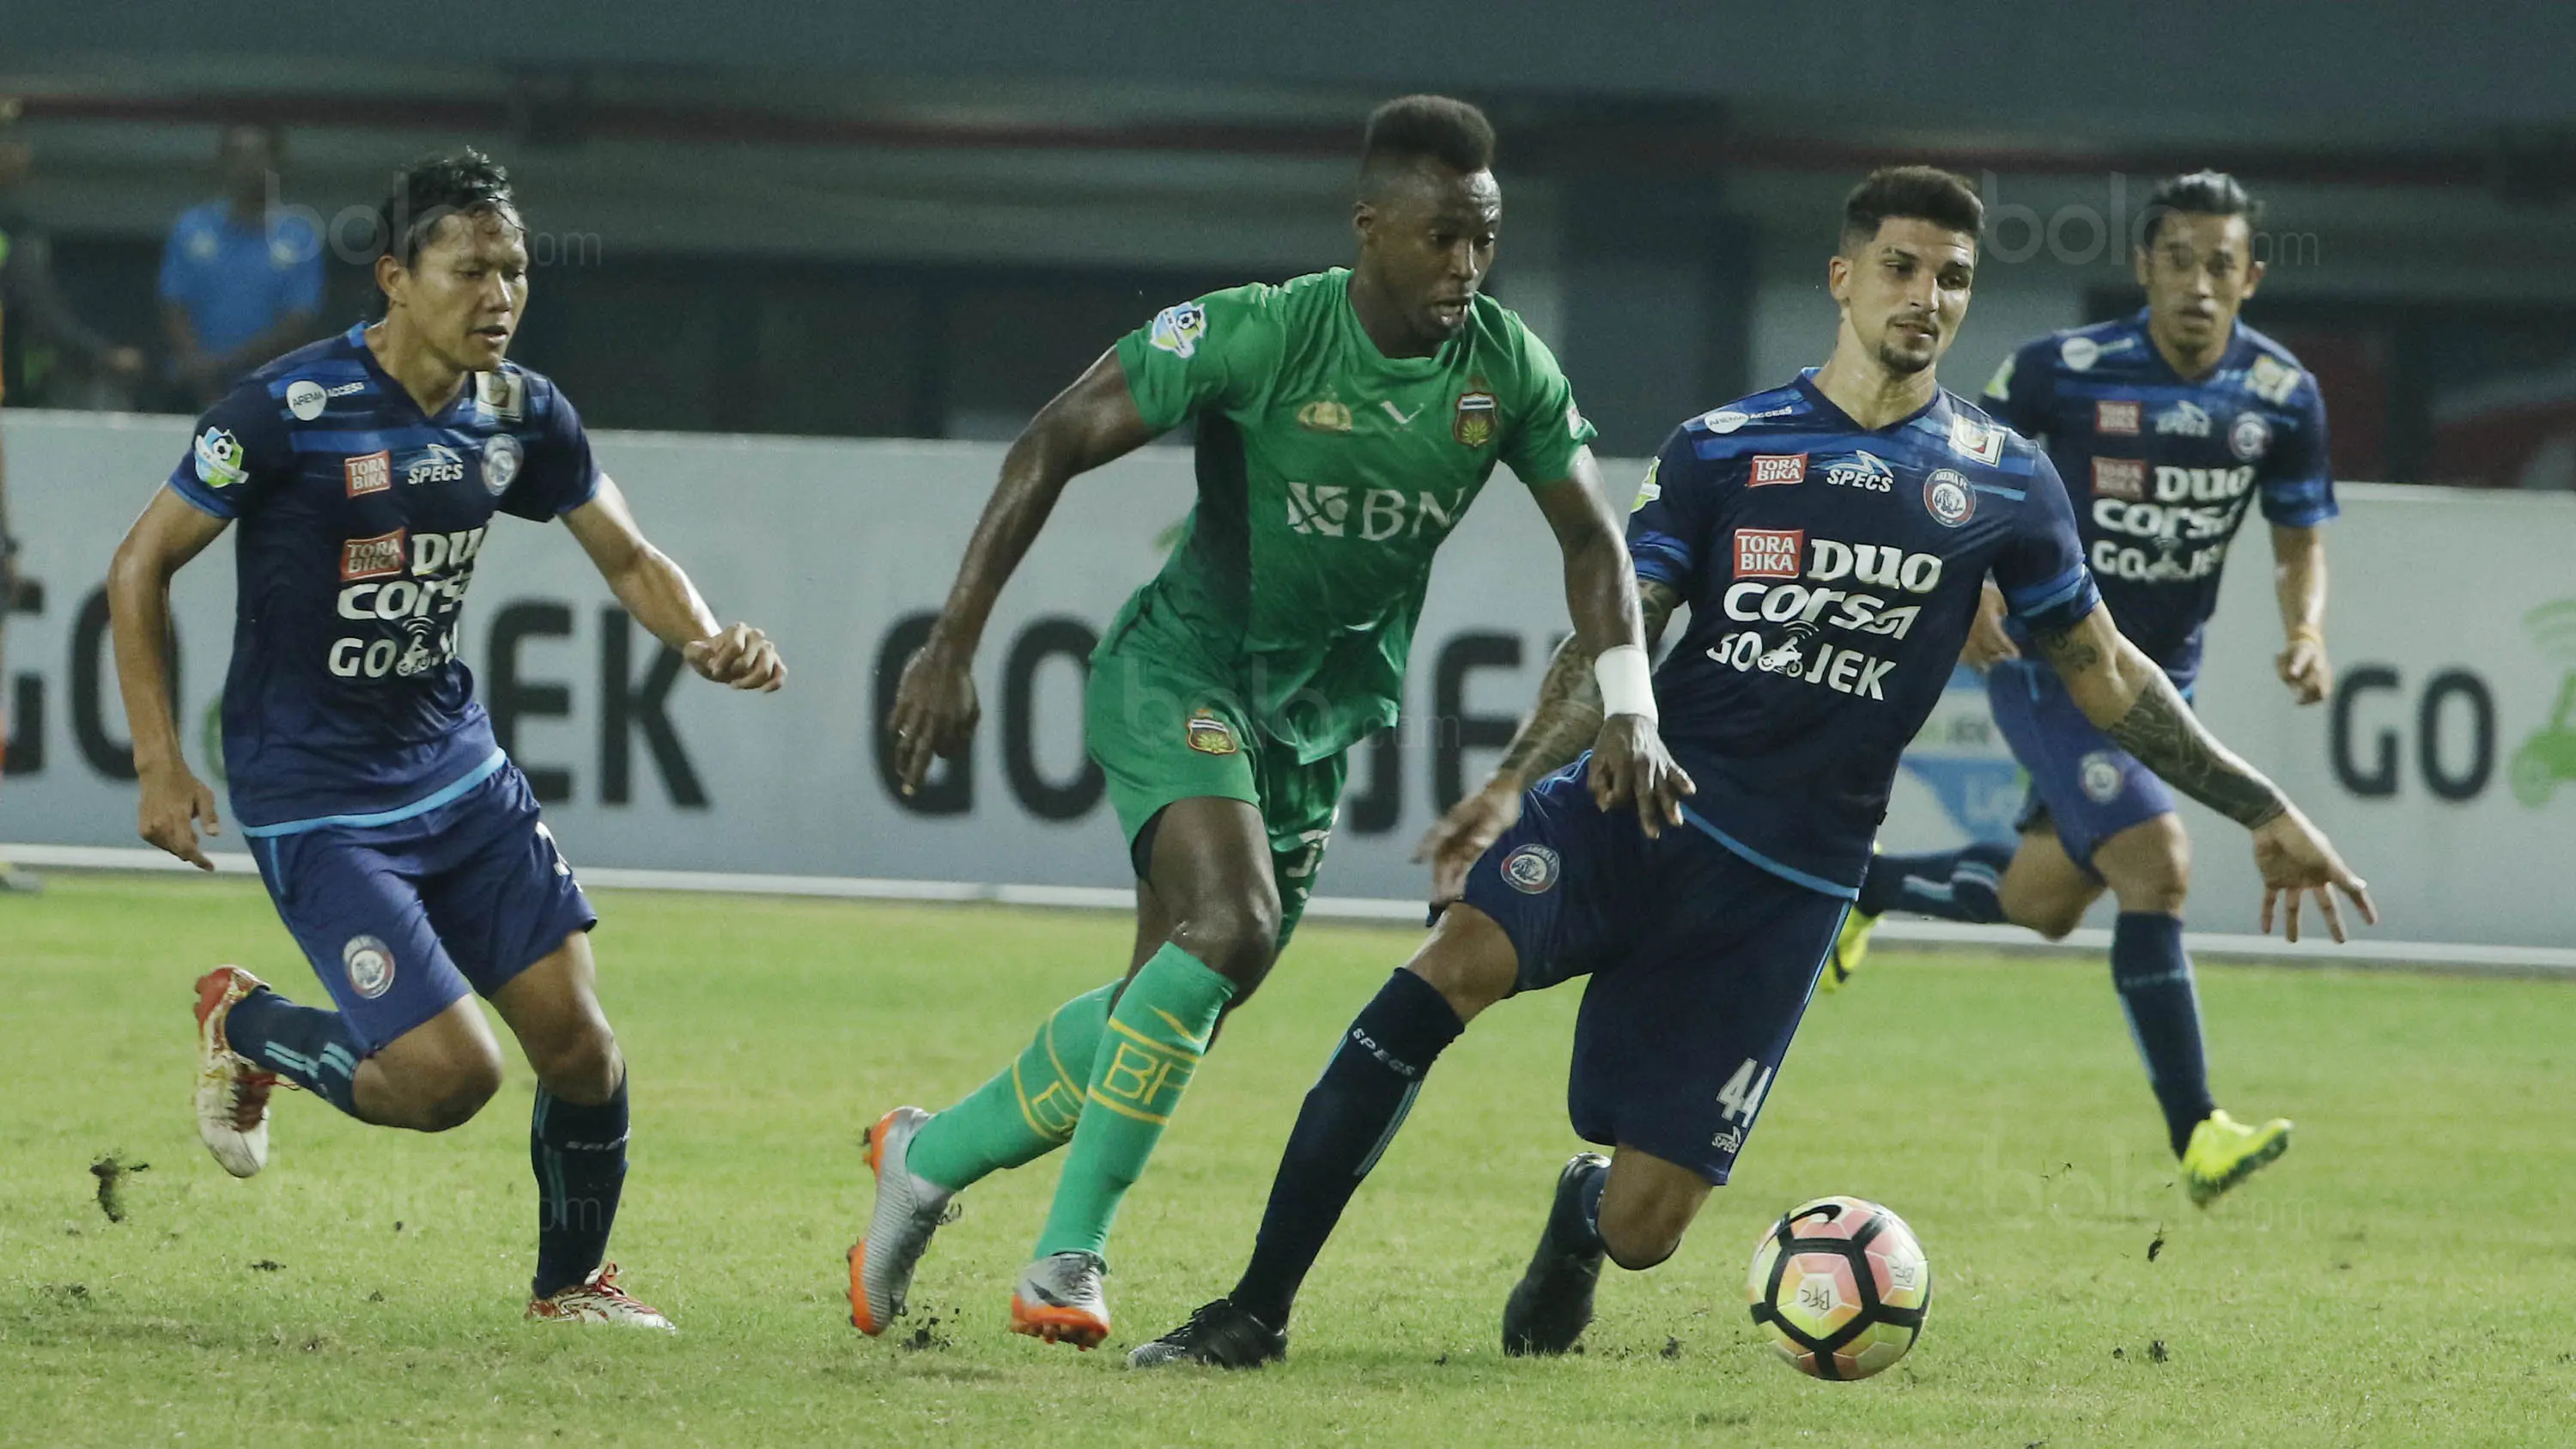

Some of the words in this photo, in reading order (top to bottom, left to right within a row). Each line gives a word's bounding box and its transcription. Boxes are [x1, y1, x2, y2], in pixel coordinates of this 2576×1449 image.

[348, 458, 386, 477] TORA
[408, 464, 464, 485] SPECS
[1754, 458, 1801, 471] TORA
[1756, 468, 1800, 482] BIKA
[352, 472, 387, 490] BIKA
[1826, 468, 1893, 492] SPECS
[348, 538, 401, 558] TORA
[1738, 535, 1796, 554] TORA
[1741, 553, 1794, 572] BIKA
[1807, 539, 1942, 594] DUO
[330, 637, 398, 678] GO
[1805, 643, 1896, 701] JEK
[2328, 663, 2499, 803] GO
[1353, 1028, 1415, 1075] SPECS
[1716, 1057, 1772, 1128] 44
[1801, 1285, 1830, 1310] BFC
